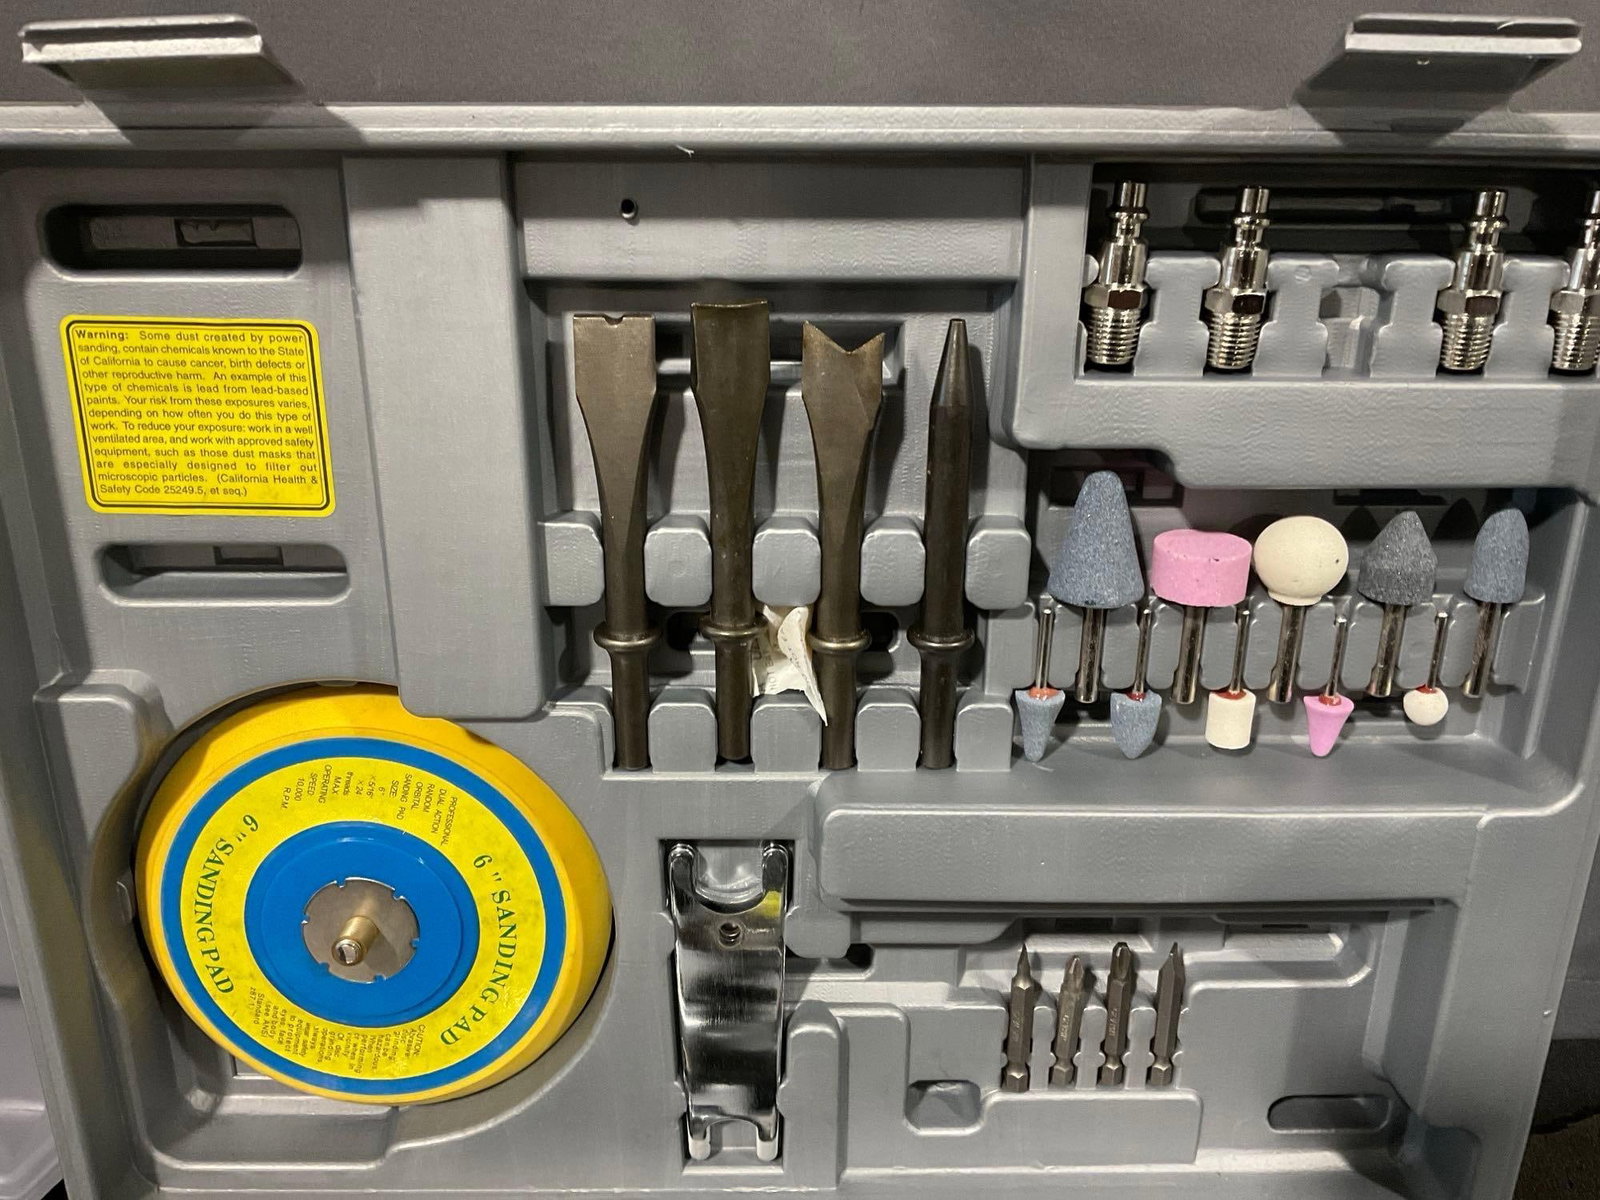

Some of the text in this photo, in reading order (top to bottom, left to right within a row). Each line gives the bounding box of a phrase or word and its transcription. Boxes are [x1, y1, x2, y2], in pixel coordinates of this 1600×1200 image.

[74, 330, 304, 344] Warning: Some dust created by power
[77, 343, 304, 356] sanding, contain chemicals known to the State
[79, 356, 305, 369] of California to cause cancer, birth defects or
[81, 370, 307, 383] other reproductive harm. An example of this
[84, 383, 308, 395] type of chemicals is lead from lead-based
[86, 395, 310, 410] paints. Your risk from these exposures varies,
[87, 409, 142, 420] depending
[160, 410, 183, 419] how
[187, 410, 212, 419] often
[216, 412, 235, 422] you
[239, 411, 251, 420] do
[255, 411, 272, 420] this
[276, 411, 298, 423] type
[302, 412, 311, 421] of
[89, 421, 118, 431] work.
[121, 422, 136, 431] To
[137, 422, 171, 431] reduce
[173, 424, 195, 434] your
[198, 423, 245, 434] exposure:
[247, 424, 271, 433] work
[273, 424, 282, 433] in
[294, 424, 313, 433] well
[92, 434, 314, 449] ventilated area, and work with approved safety
[94, 448, 317, 459] equipment, such as those dust masks that
[123, 460, 177, 472] especially
[187, 461, 237, 473] designed
[245, 462, 256, 471] to
[265, 462, 290, 471] filter
[298, 463, 318, 472] out
[97, 473, 318, 486] microscopic particles. (California Health &
[99, 484, 247, 497] Safety Code 25249.5, et seq.)
[318, 764, 332, 804] OPERATING
[332, 776, 342, 794] MAX
[396, 773, 412, 820] SANDING PAD
[411, 782, 423, 810] ORBITAL
[424, 784, 435, 812] RANDOM
[431, 788, 446, 834] DUAL ACTION
[441, 796, 458, 846] PROFESSIONAL
[194, 838, 234, 943] SANDING
[480, 890, 517, 1004] SANDING
[201, 948, 234, 994] PAD
[254, 992, 264, 1024] Standard
[270, 1020, 278, 1038] body
[440, 1004, 486, 1046] PAD
[278, 1030, 286, 1044] face
[285, 1024, 294, 1052] protect
[294, 1019, 302, 1054] equipment
[354, 1034, 368, 1074] performing
